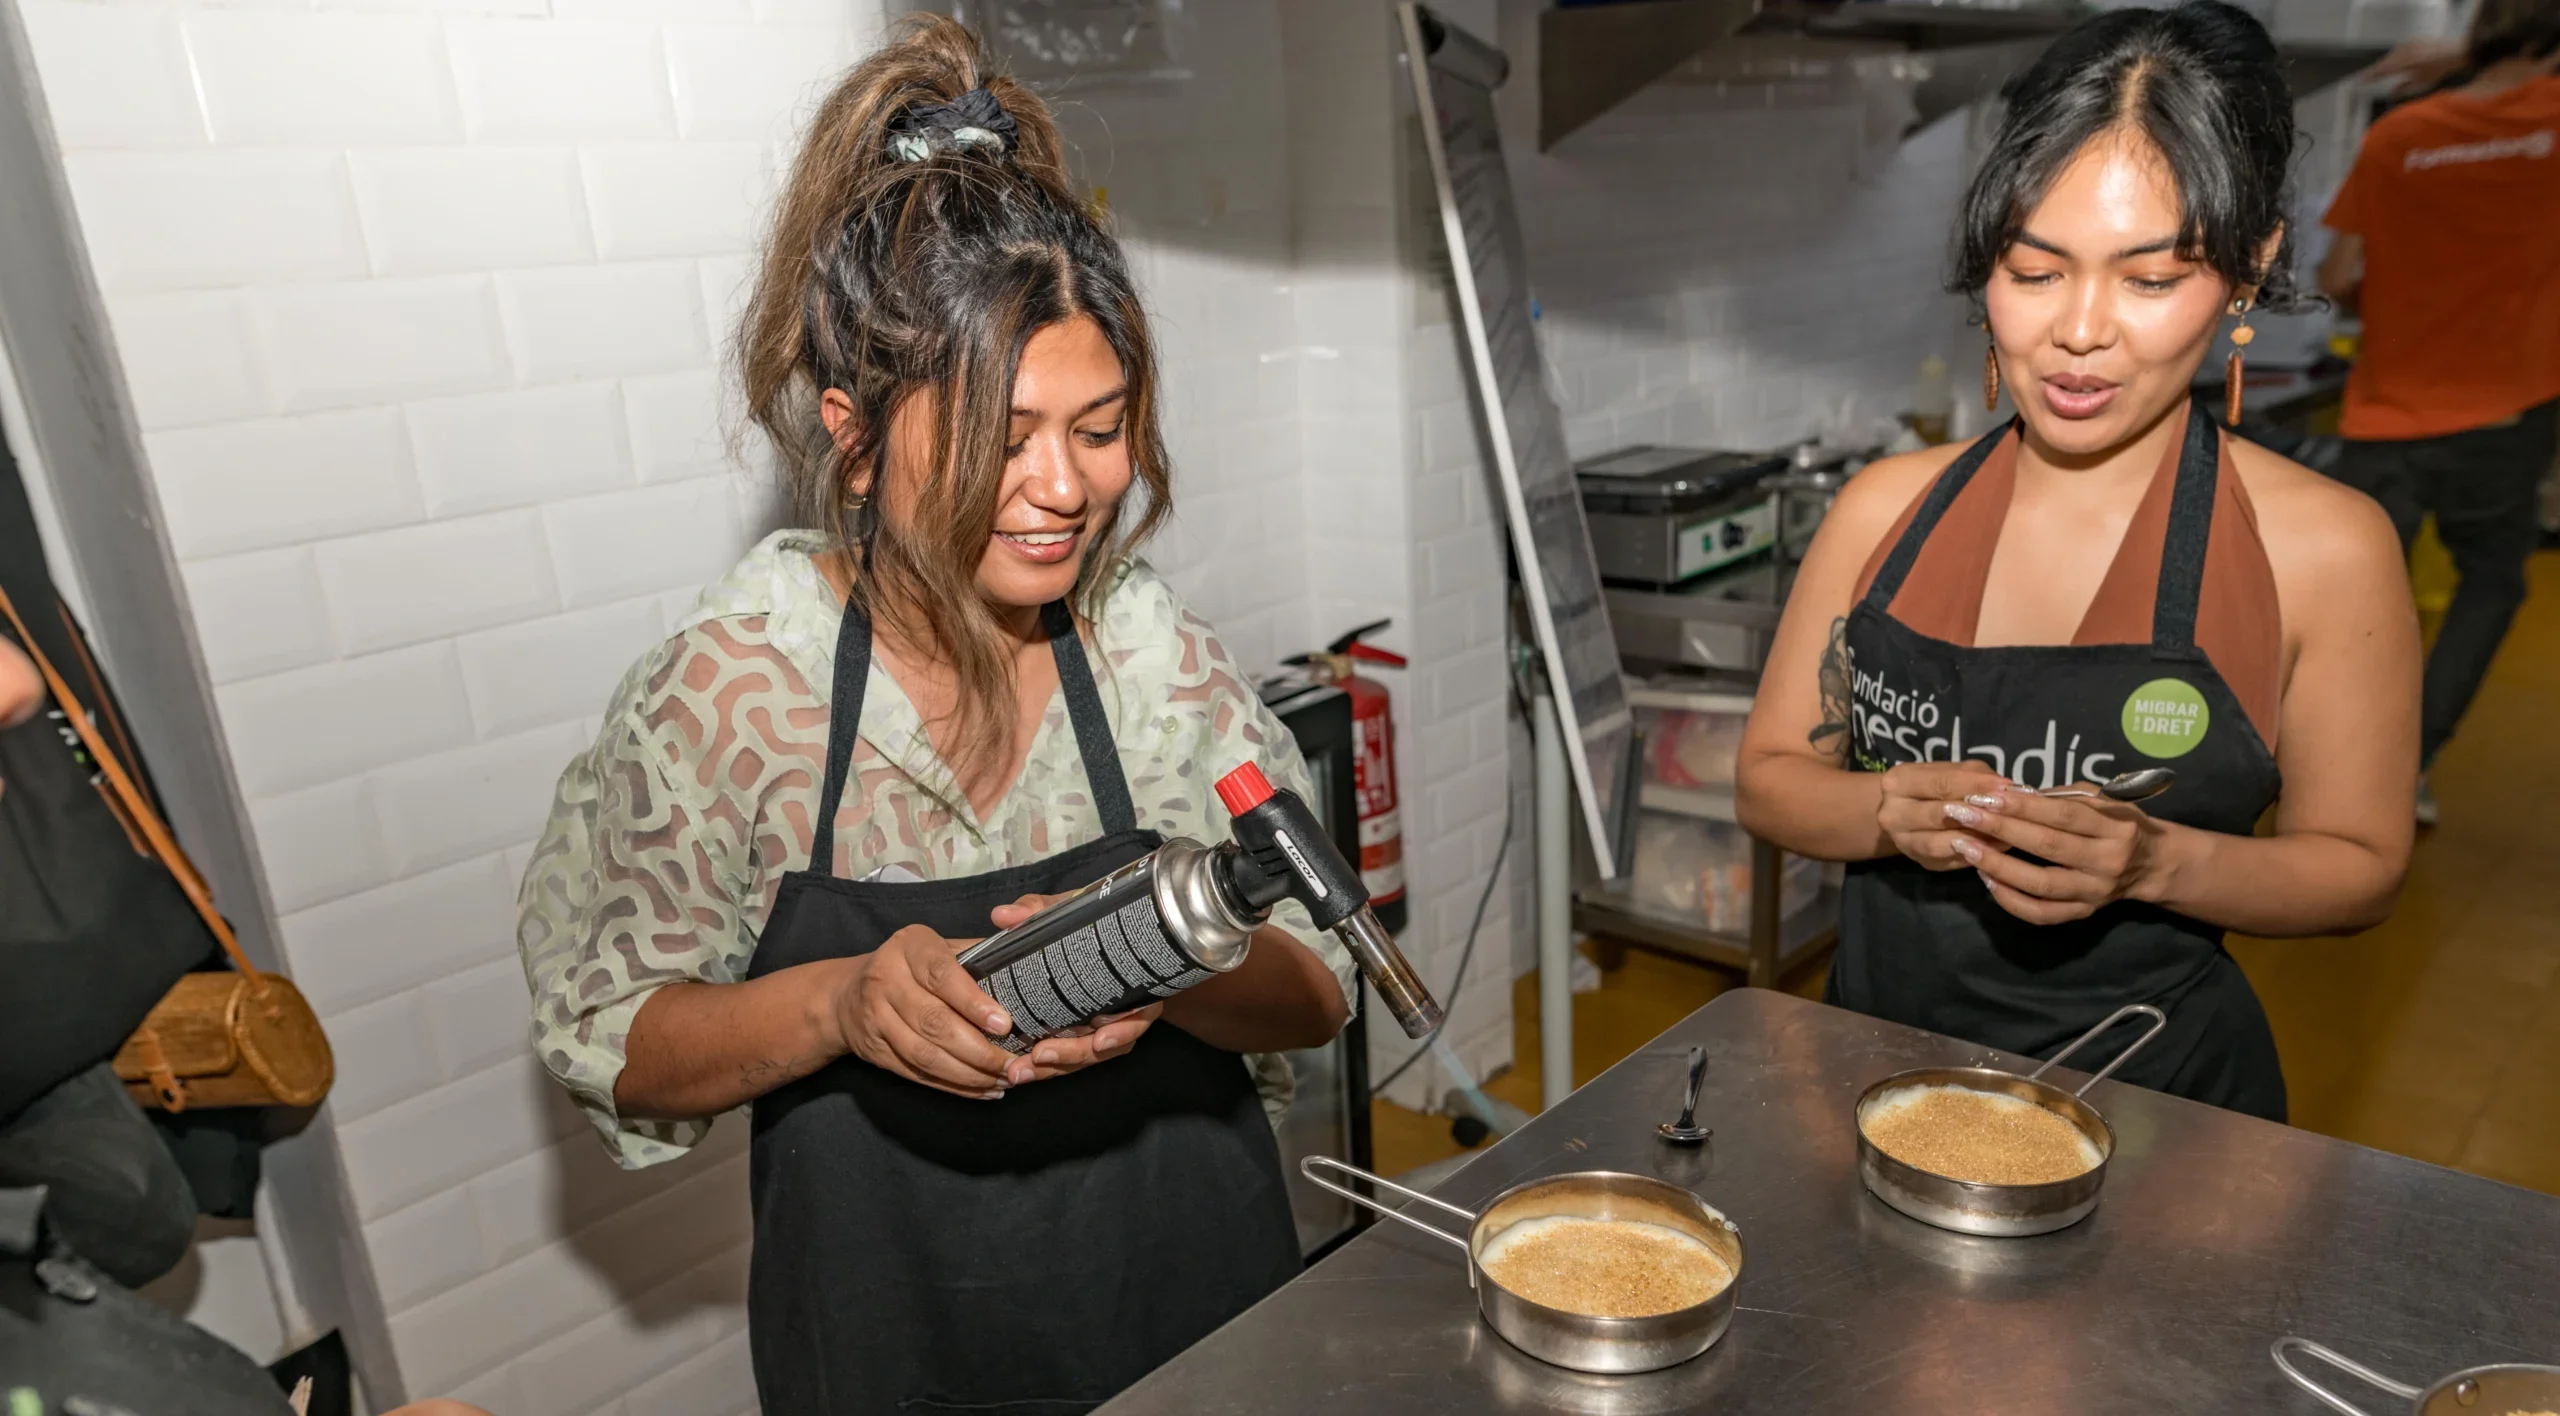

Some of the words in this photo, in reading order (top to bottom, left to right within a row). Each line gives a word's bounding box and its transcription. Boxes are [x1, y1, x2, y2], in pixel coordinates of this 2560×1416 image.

[2135, 699, 2199, 718] MIGRAR
[2143, 716, 2196, 737] DRET
[1286, 845, 1317, 881] Lacor
